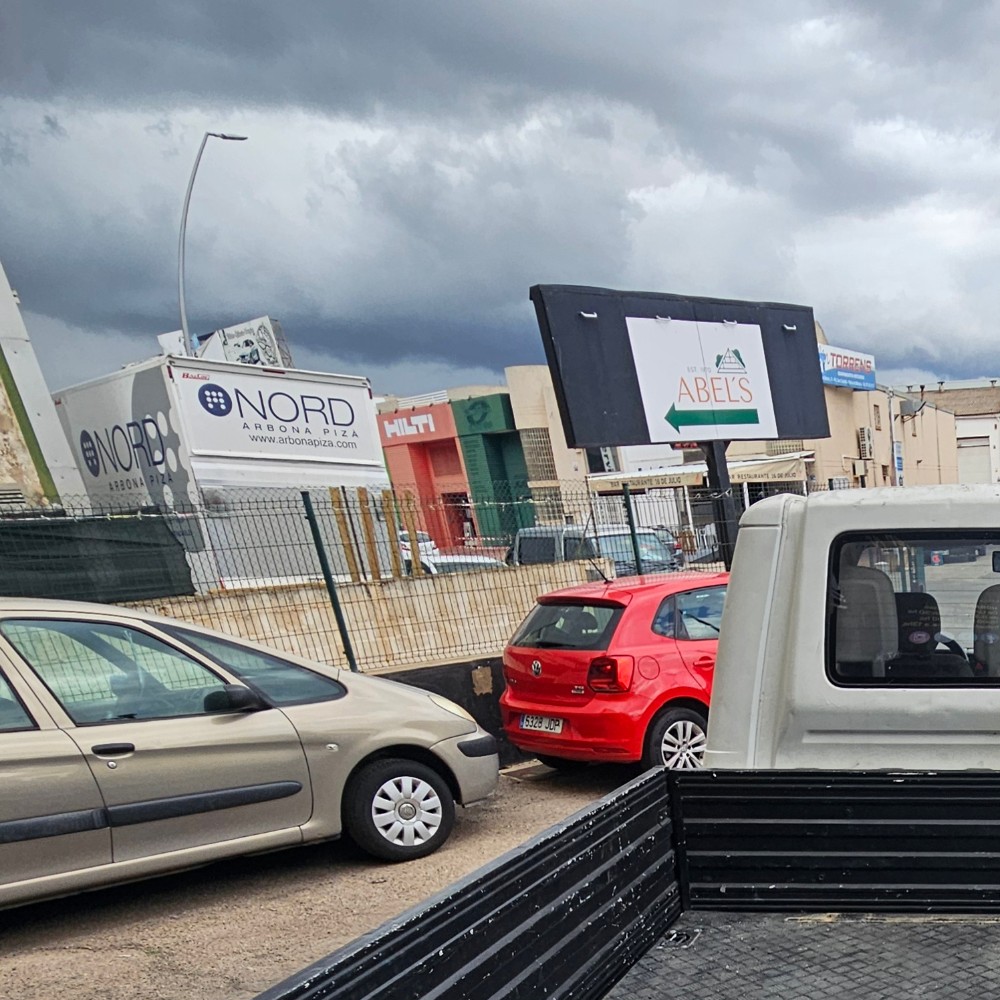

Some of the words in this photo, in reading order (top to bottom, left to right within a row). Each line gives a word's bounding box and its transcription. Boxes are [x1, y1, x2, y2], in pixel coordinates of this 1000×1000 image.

[678, 376, 753, 403] ABEL'S
[234, 388, 355, 427] NORD
[243, 422, 312, 435] ARBONA
[383, 413, 435, 438] HILTI
[94, 418, 165, 475] NORD
[249, 433, 358, 449] www.arbonapiza.com
